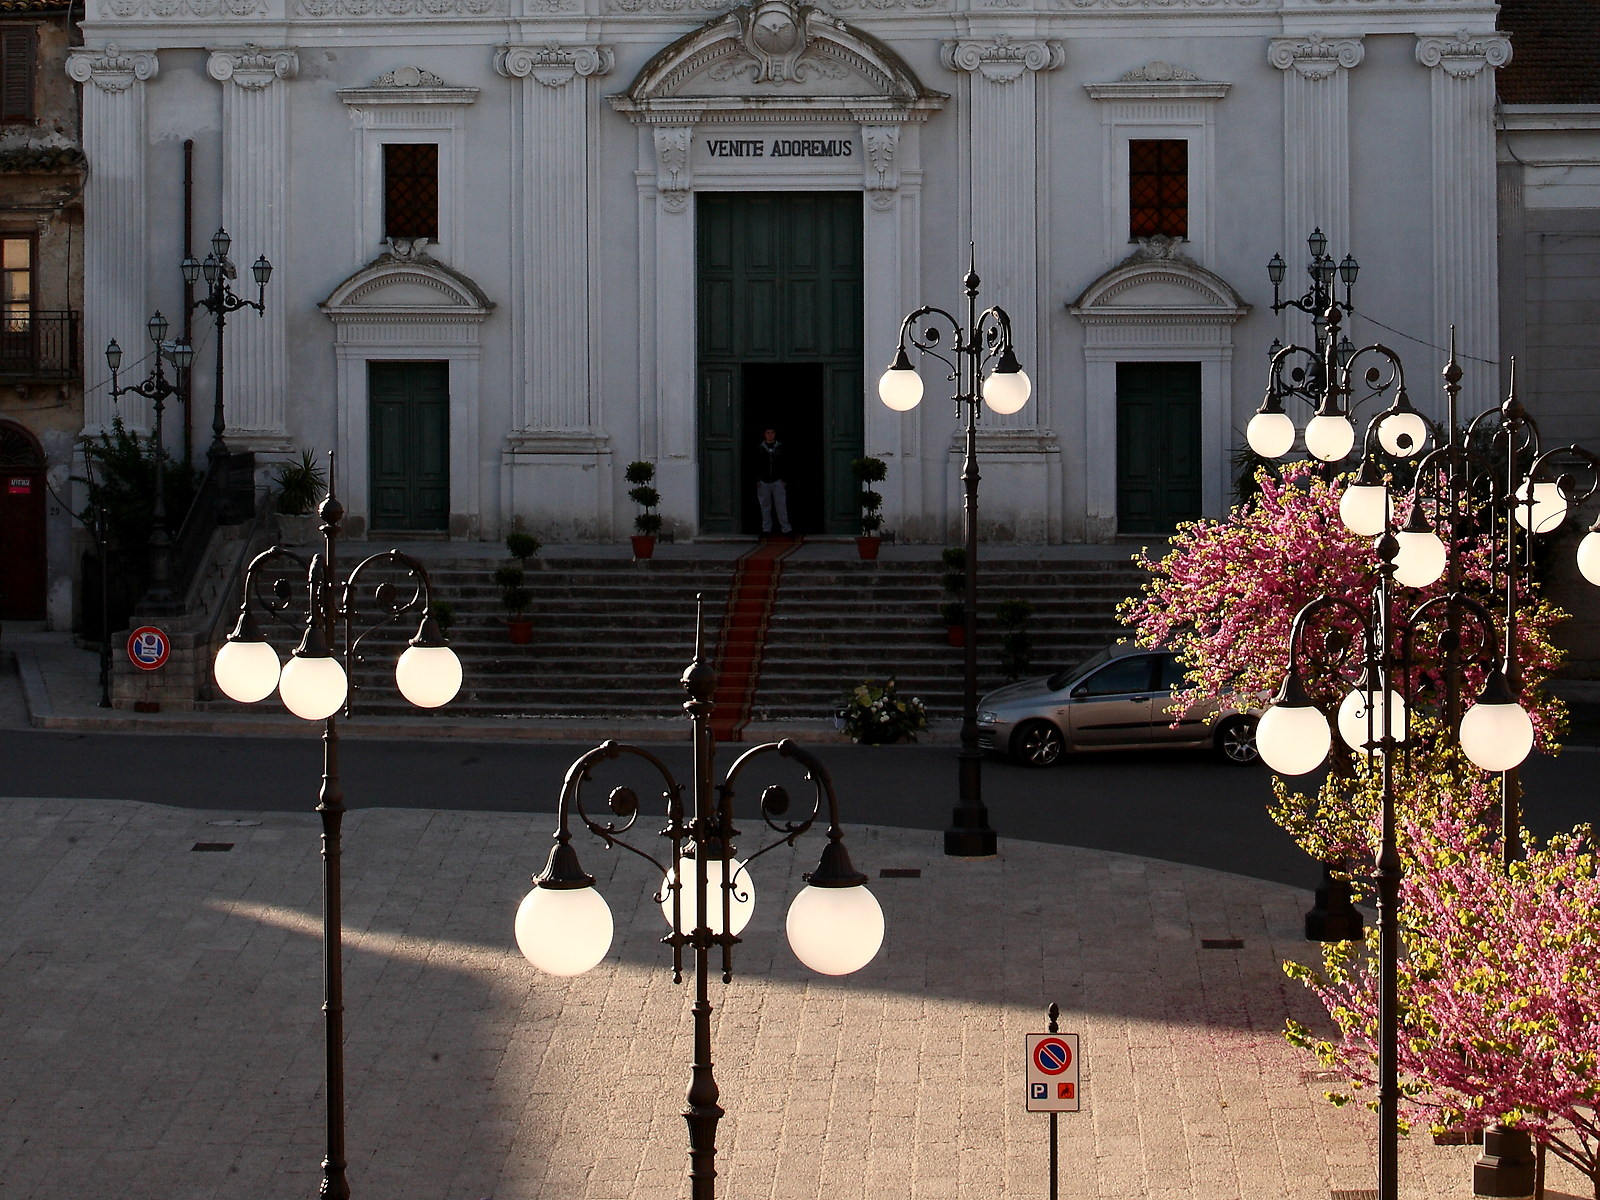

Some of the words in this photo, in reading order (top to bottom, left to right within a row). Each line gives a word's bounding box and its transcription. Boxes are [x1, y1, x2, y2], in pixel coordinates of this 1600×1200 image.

[706, 140, 764, 157] VENITE
[770, 140, 852, 157] ADOREMUS
[1034, 1085, 1044, 1097] P
